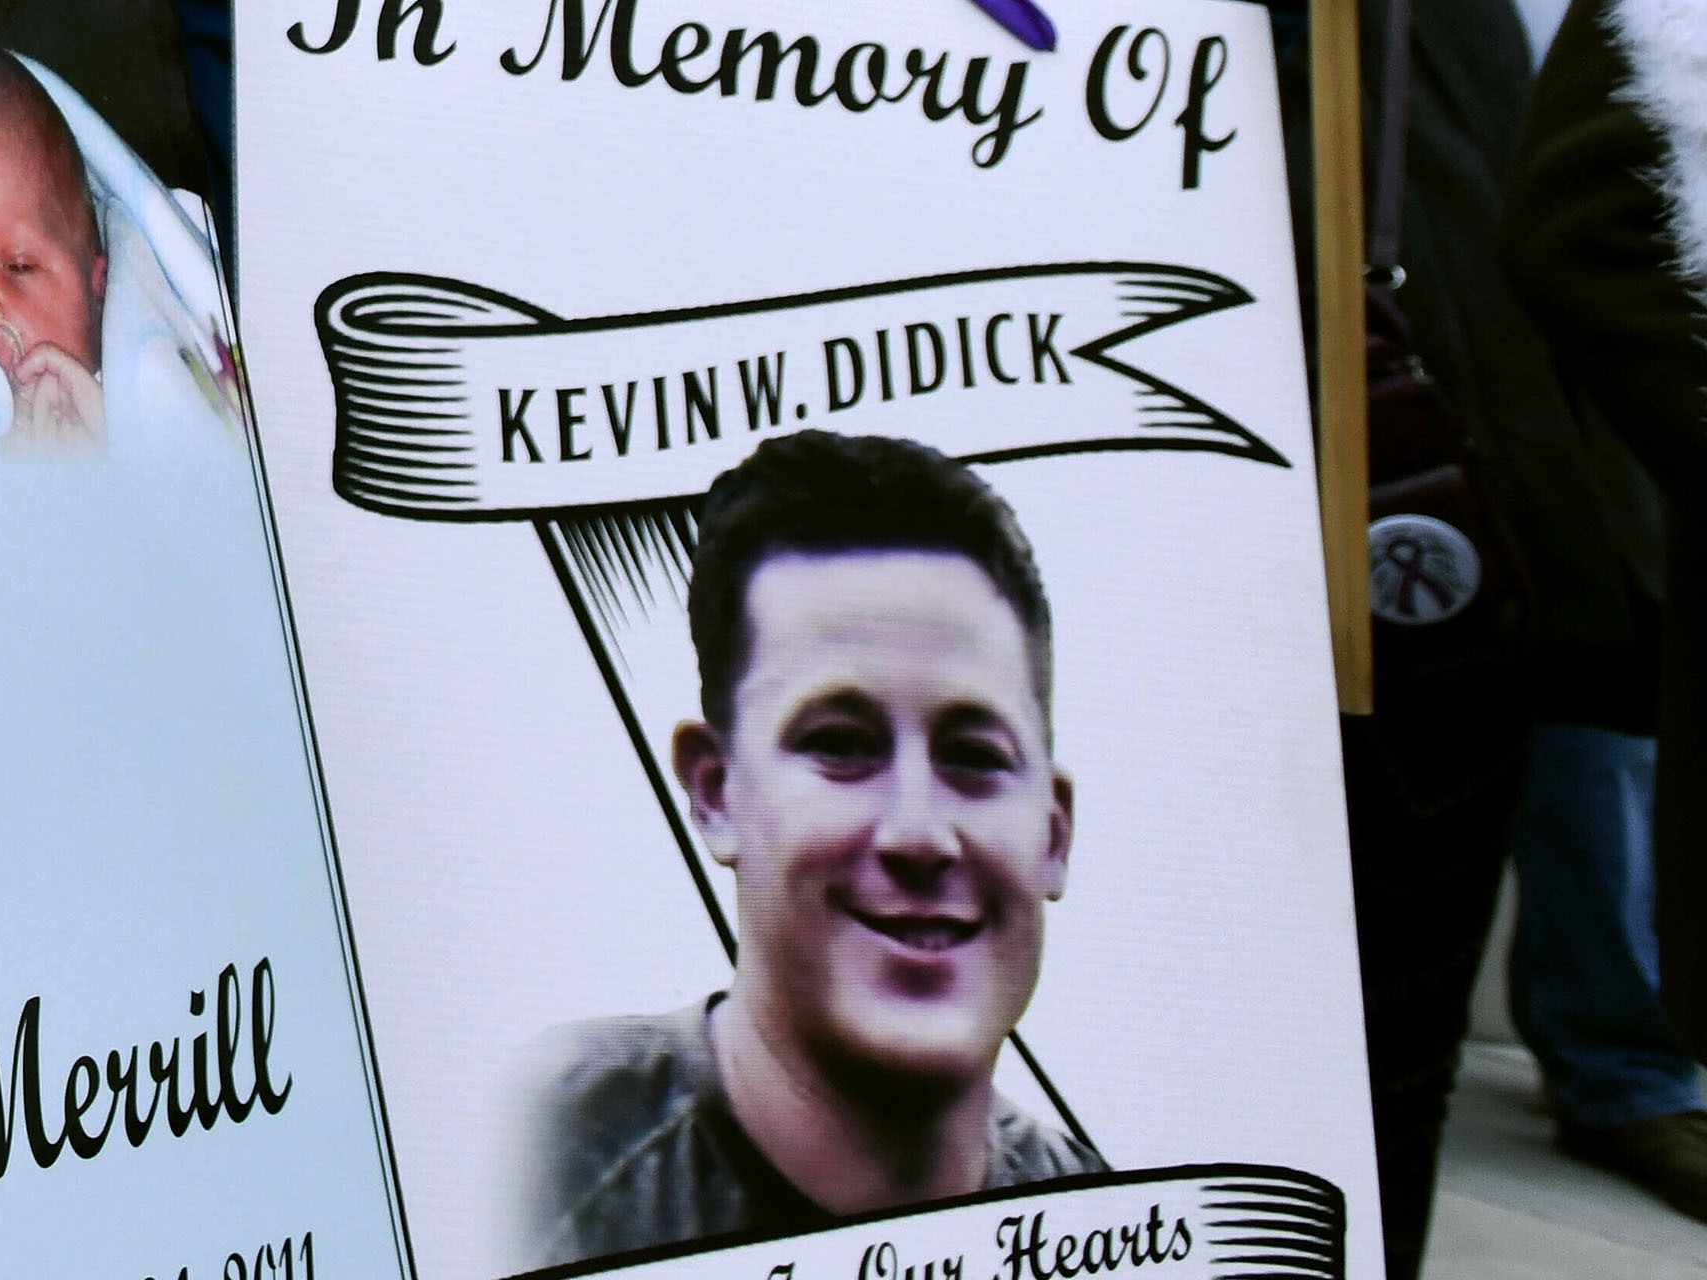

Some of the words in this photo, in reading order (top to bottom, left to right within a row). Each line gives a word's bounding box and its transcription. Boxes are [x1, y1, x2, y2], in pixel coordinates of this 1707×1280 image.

[1085, 22, 1235, 190] Of
[497, 363, 721, 464] KEVIN
[736, 351, 809, 430] W.
[823, 312, 1072, 414] DIDICK
[992, 1204, 1193, 1280] Hearts
